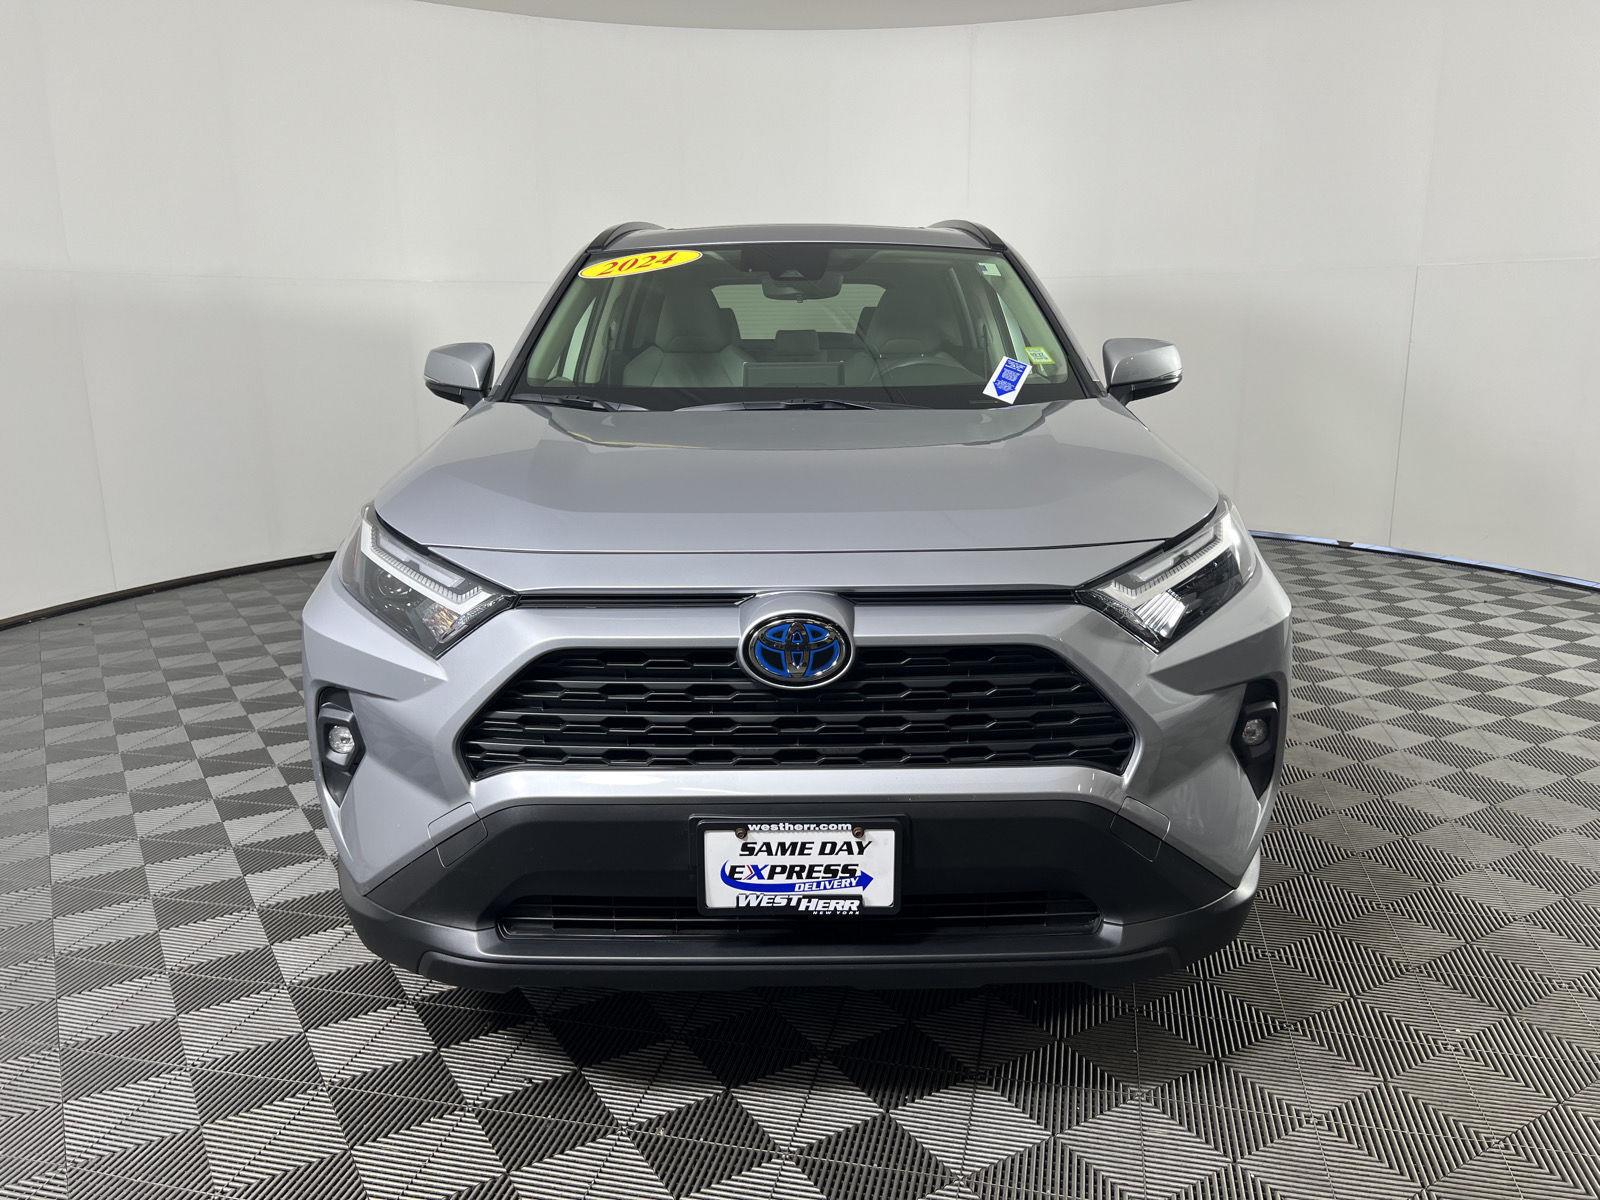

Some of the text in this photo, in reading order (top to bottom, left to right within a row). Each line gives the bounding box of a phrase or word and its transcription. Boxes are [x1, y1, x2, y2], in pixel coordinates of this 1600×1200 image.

[597, 252, 678, 276] 2024
[747, 823, 852, 831] westherr.com
[739, 841, 872, 856] SAME DAY
[728, 863, 859, 880] EXPRESS
[794, 877, 860, 892] DELIVERY
